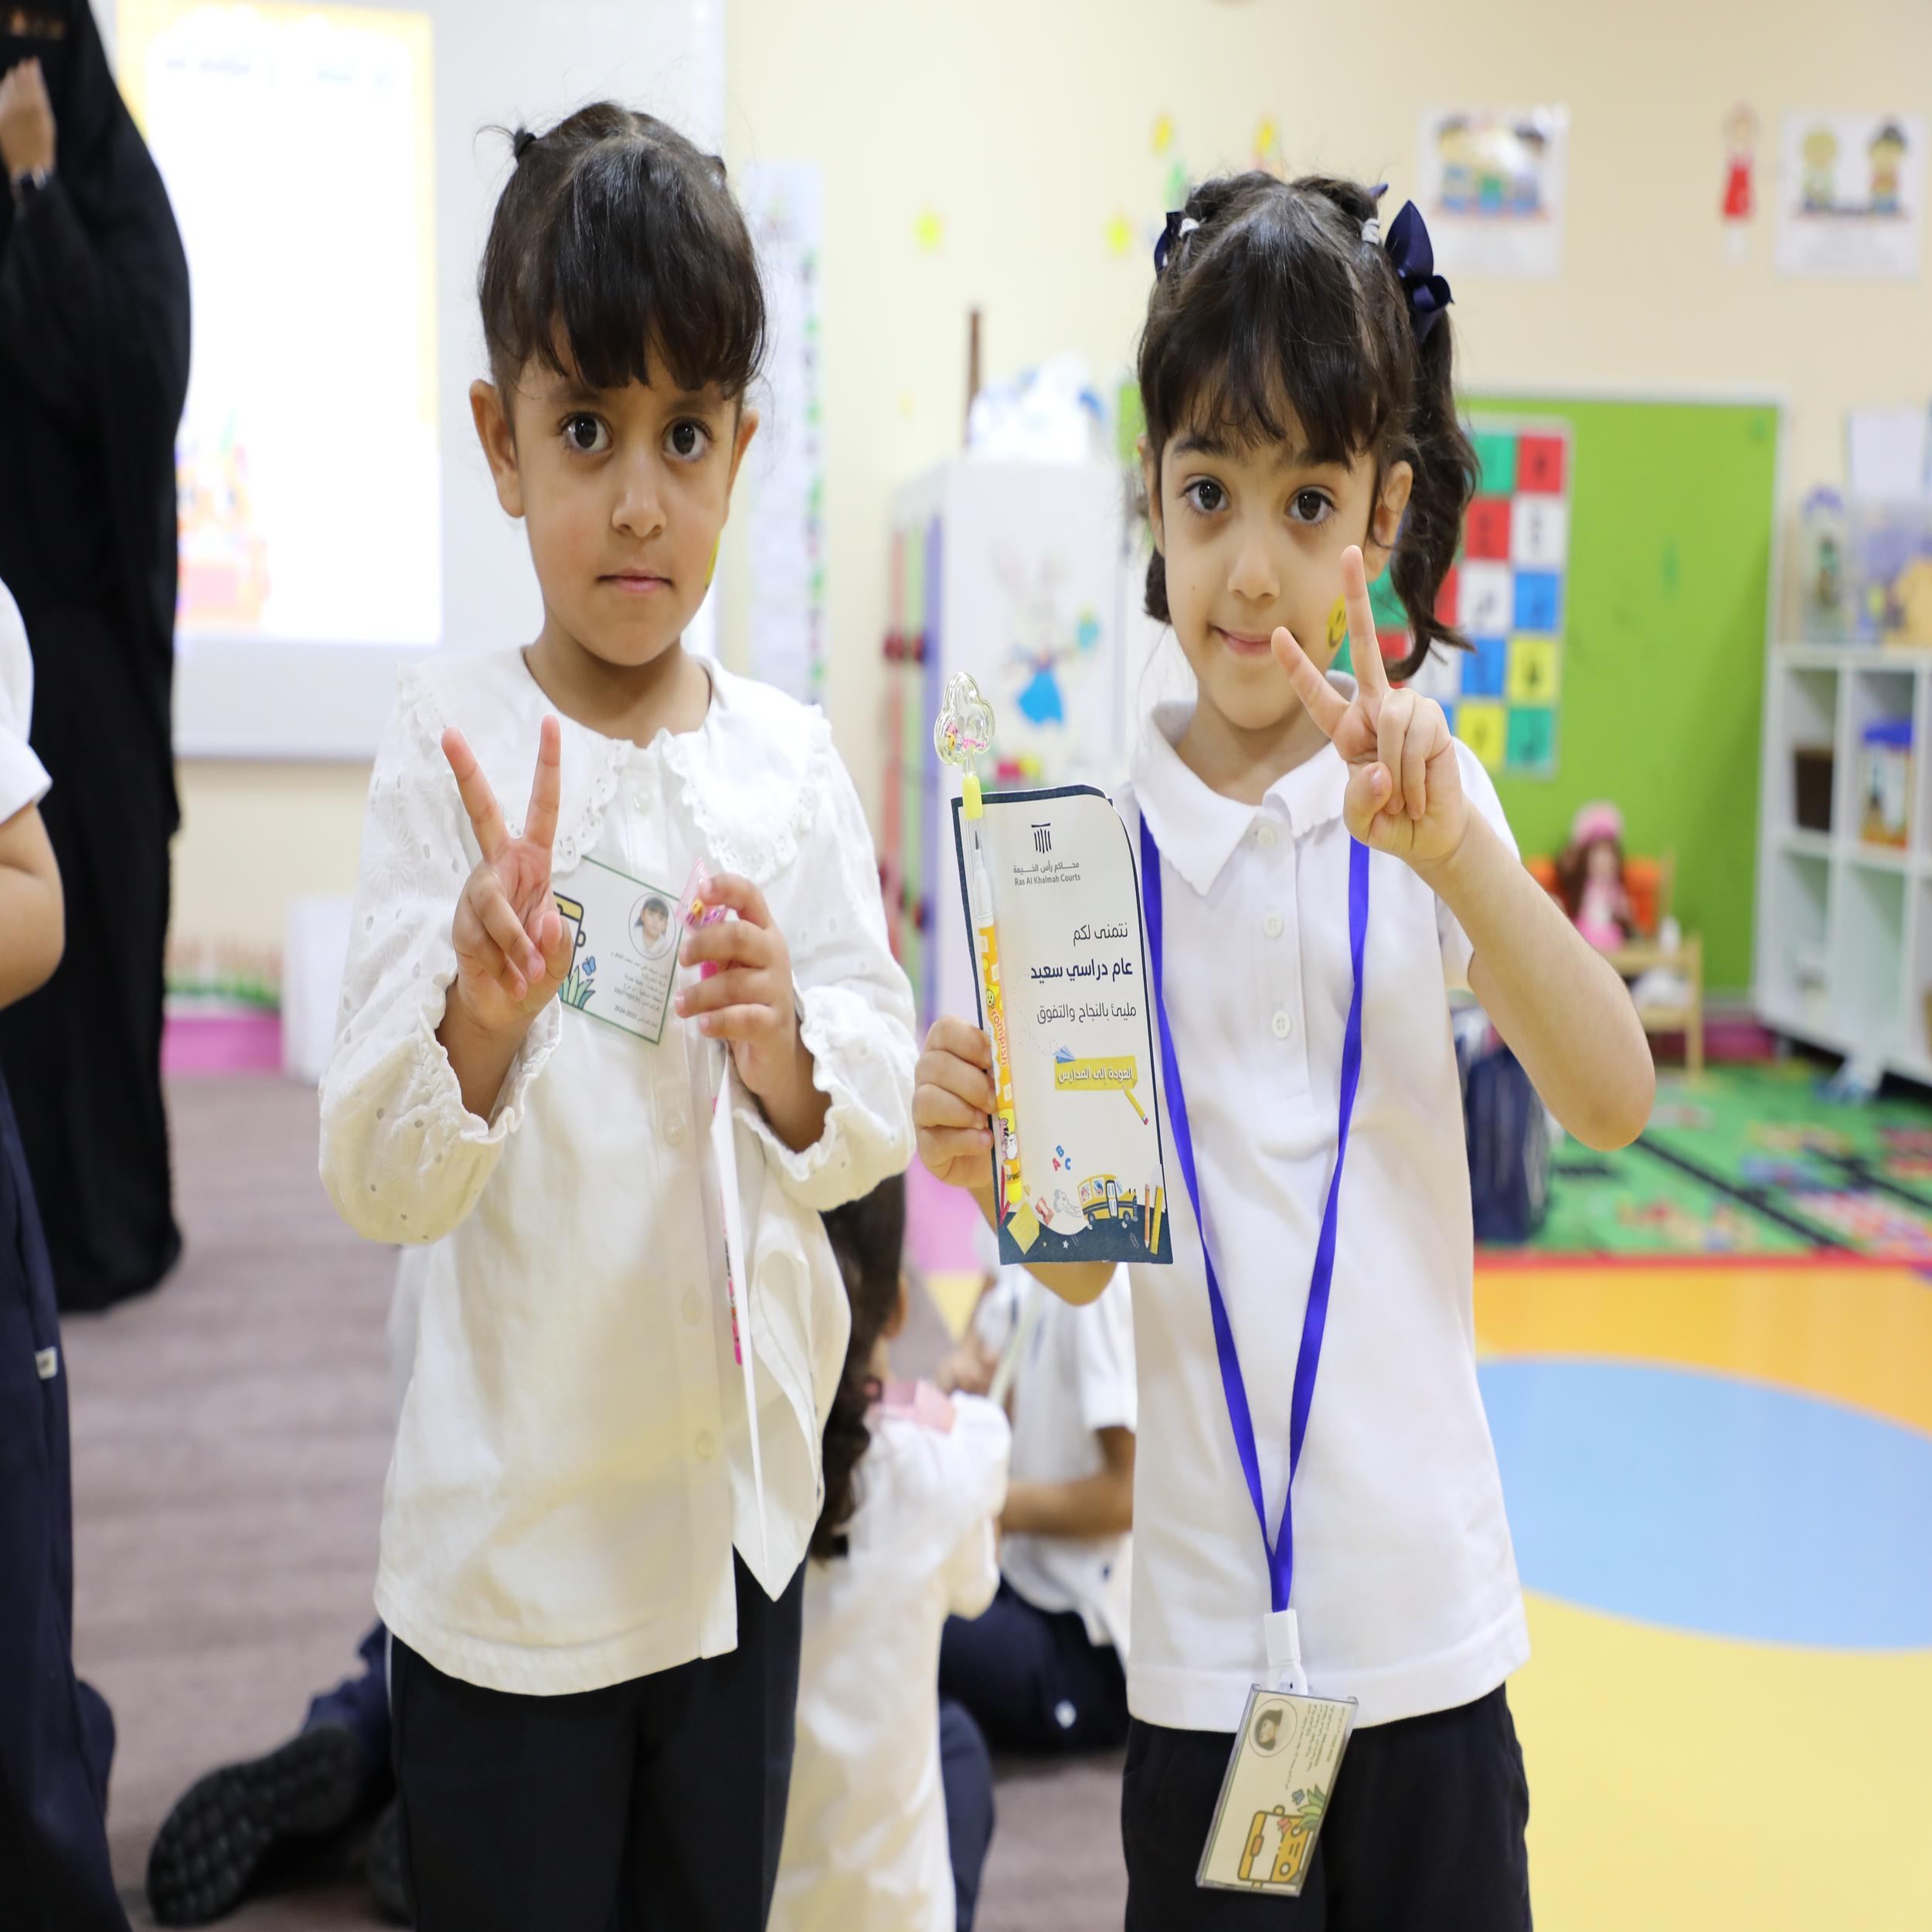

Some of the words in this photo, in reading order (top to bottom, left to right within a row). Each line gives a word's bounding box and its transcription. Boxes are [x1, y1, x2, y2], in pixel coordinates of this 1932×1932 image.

[1040, 859, 1053, 873] رأس
[1014, 877, 1026, 886] Ras
[1026, 876, 1033, 885] Al
[1033, 875, 1060, 885] Khaimah
[1060, 873, 1081, 883] Courts
[1073, 924, 1091, 947] لكم
[1094, 922, 1128, 939] نتمنى
[1031, 965, 1063, 985] سعيد
[1066, 958, 1108, 981] دراسي
[1112, 957, 1133, 982] عام
[1036, 1003, 1076, 1025] والتفوق
[1078, 1002, 1109, 1023] بالنجاح
[1058, 1067, 1091, 1084] المدارس
[1093, 1066, 1107, 1084] إلى
[1108, 1066, 1134, 1083] العودة
[1056, 1145, 1065, 1158] B
[1065, 1158, 1071, 1171] C
